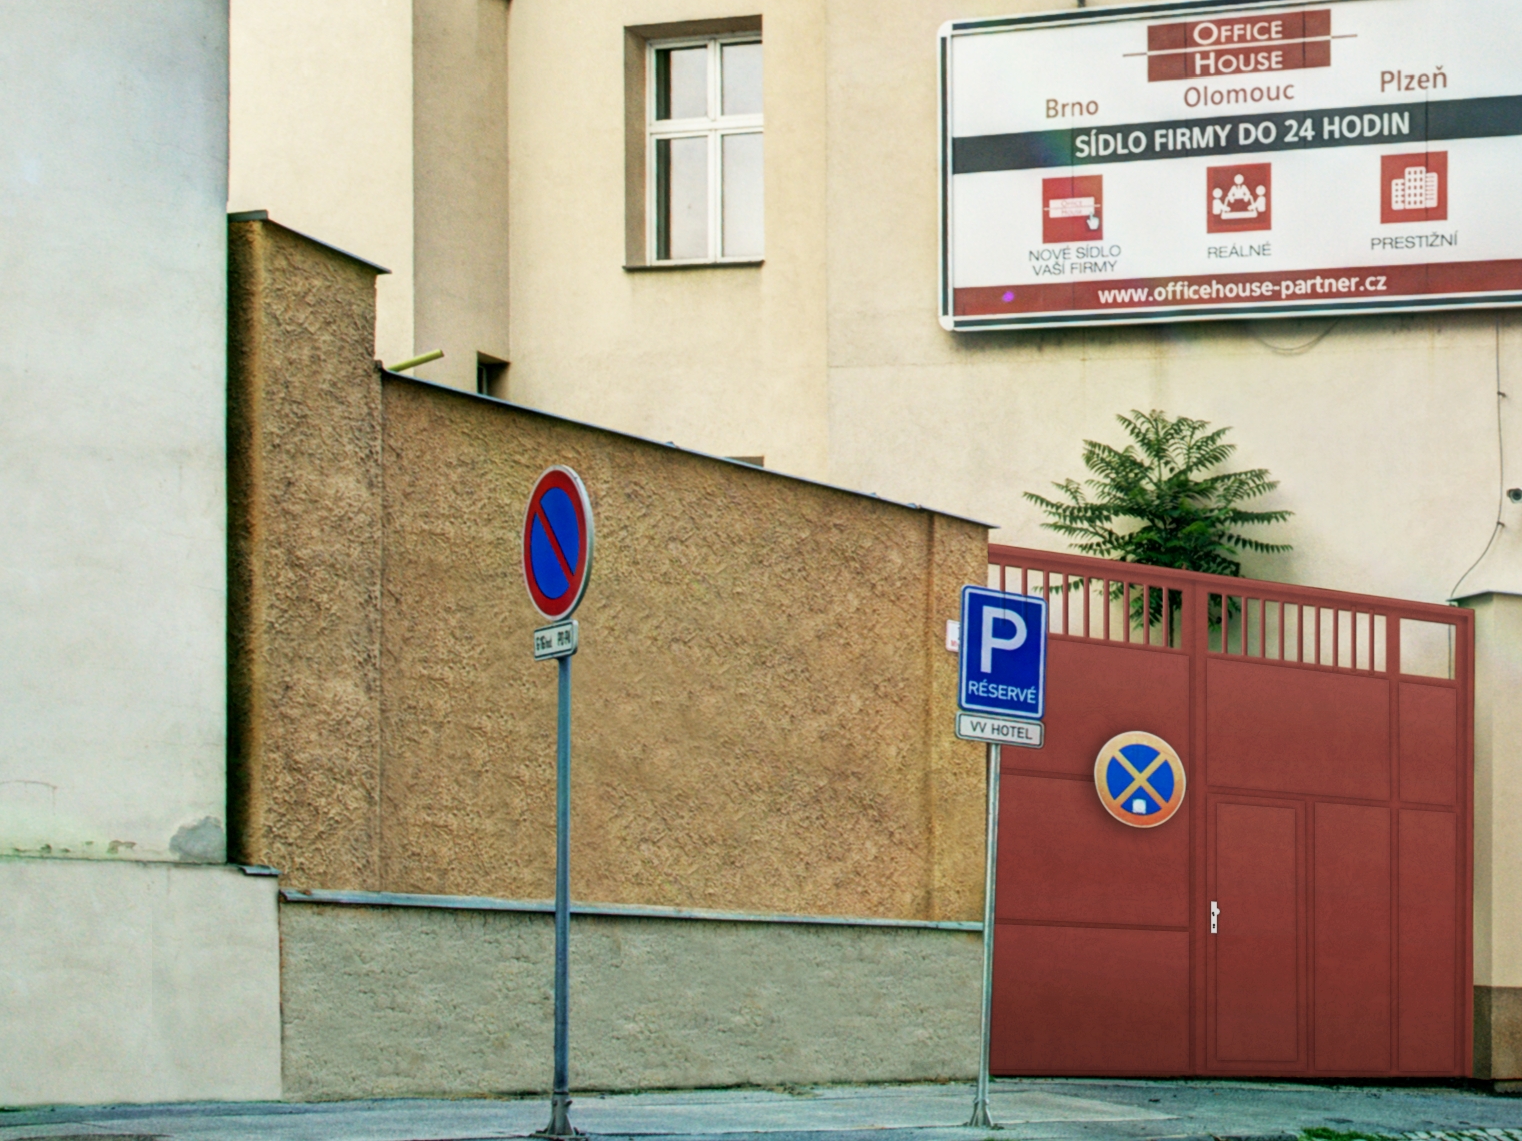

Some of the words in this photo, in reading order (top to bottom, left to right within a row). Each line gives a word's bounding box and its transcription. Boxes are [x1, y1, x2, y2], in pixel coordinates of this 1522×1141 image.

[1193, 20, 1283, 45] OFFICE
[1194, 50, 1283, 75] HOUSE
[1380, 64, 1448, 93] Plzeň
[1183, 83, 1295, 108] Olomouc
[1045, 98, 1099, 119] Brno
[1074, 128, 1147, 158] SÍDLO
[1154, 123, 1232, 152] FIRMY
[1238, 120, 1277, 146] DO
[1284, 118, 1316, 143] 24
[1323, 111, 1410, 140] HODIN
[1207, 241, 1272, 259] REÁLNÉ
[1370, 230, 1458, 250] PRESTIŽNÍ
[1028, 245, 1071, 262] NOVÉ
[1076, 244, 1122, 259] SÍDLO
[1070, 260, 1118, 275] FIRMY
[1097, 275, 1388, 304] www.officehouse-partner.cz
[980, 605, 1028, 674] P
[968, 679, 1037, 704] RÉSERVÉ
[991, 723, 1033, 740] HOTEL
